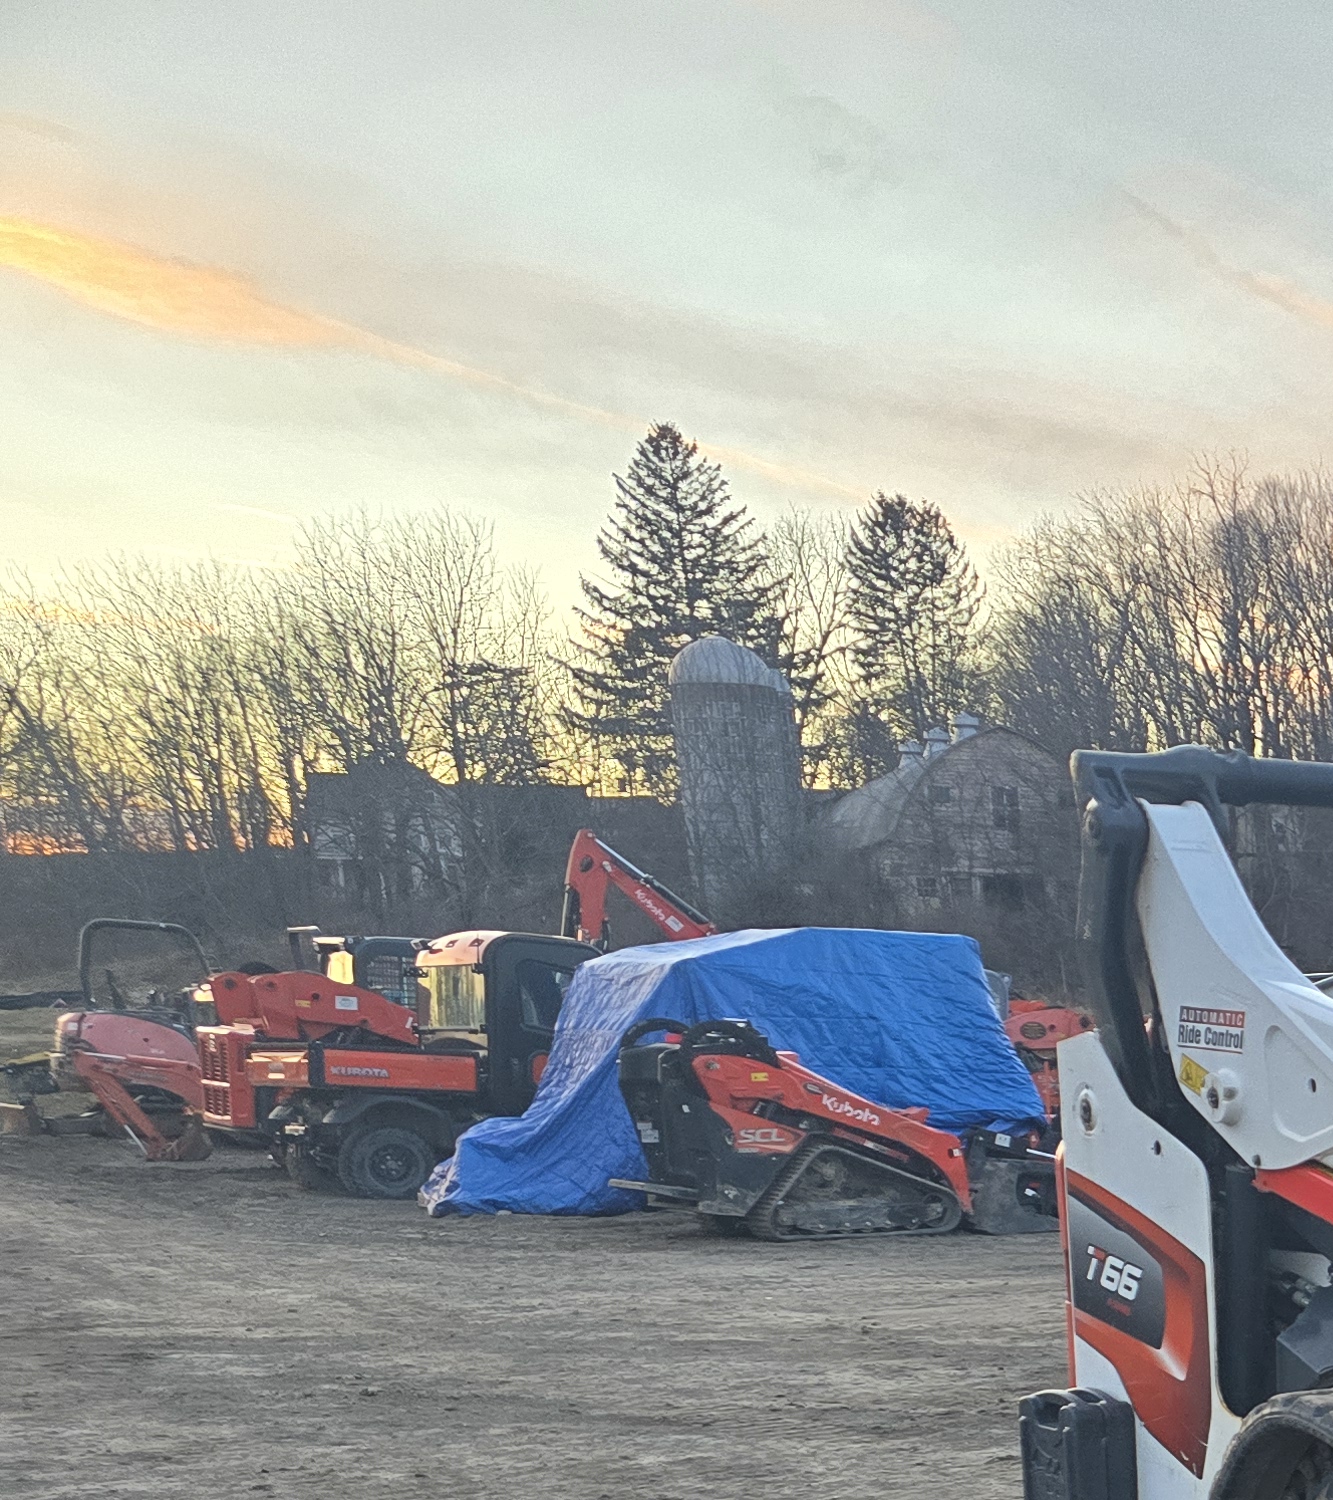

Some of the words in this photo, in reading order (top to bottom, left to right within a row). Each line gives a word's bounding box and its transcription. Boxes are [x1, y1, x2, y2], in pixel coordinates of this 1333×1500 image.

[634, 888, 666, 921] Kubota
[1181, 1008, 1244, 1026] AUTOMATIC
[1178, 1024, 1202, 1045] Ride
[1204, 1026, 1245, 1050] Control
[330, 1065, 390, 1078] KUBOTA
[821, 1093, 881, 1126] Kubota
[738, 1127, 785, 1144] SCL
[1086, 1245, 1143, 1301] T66
